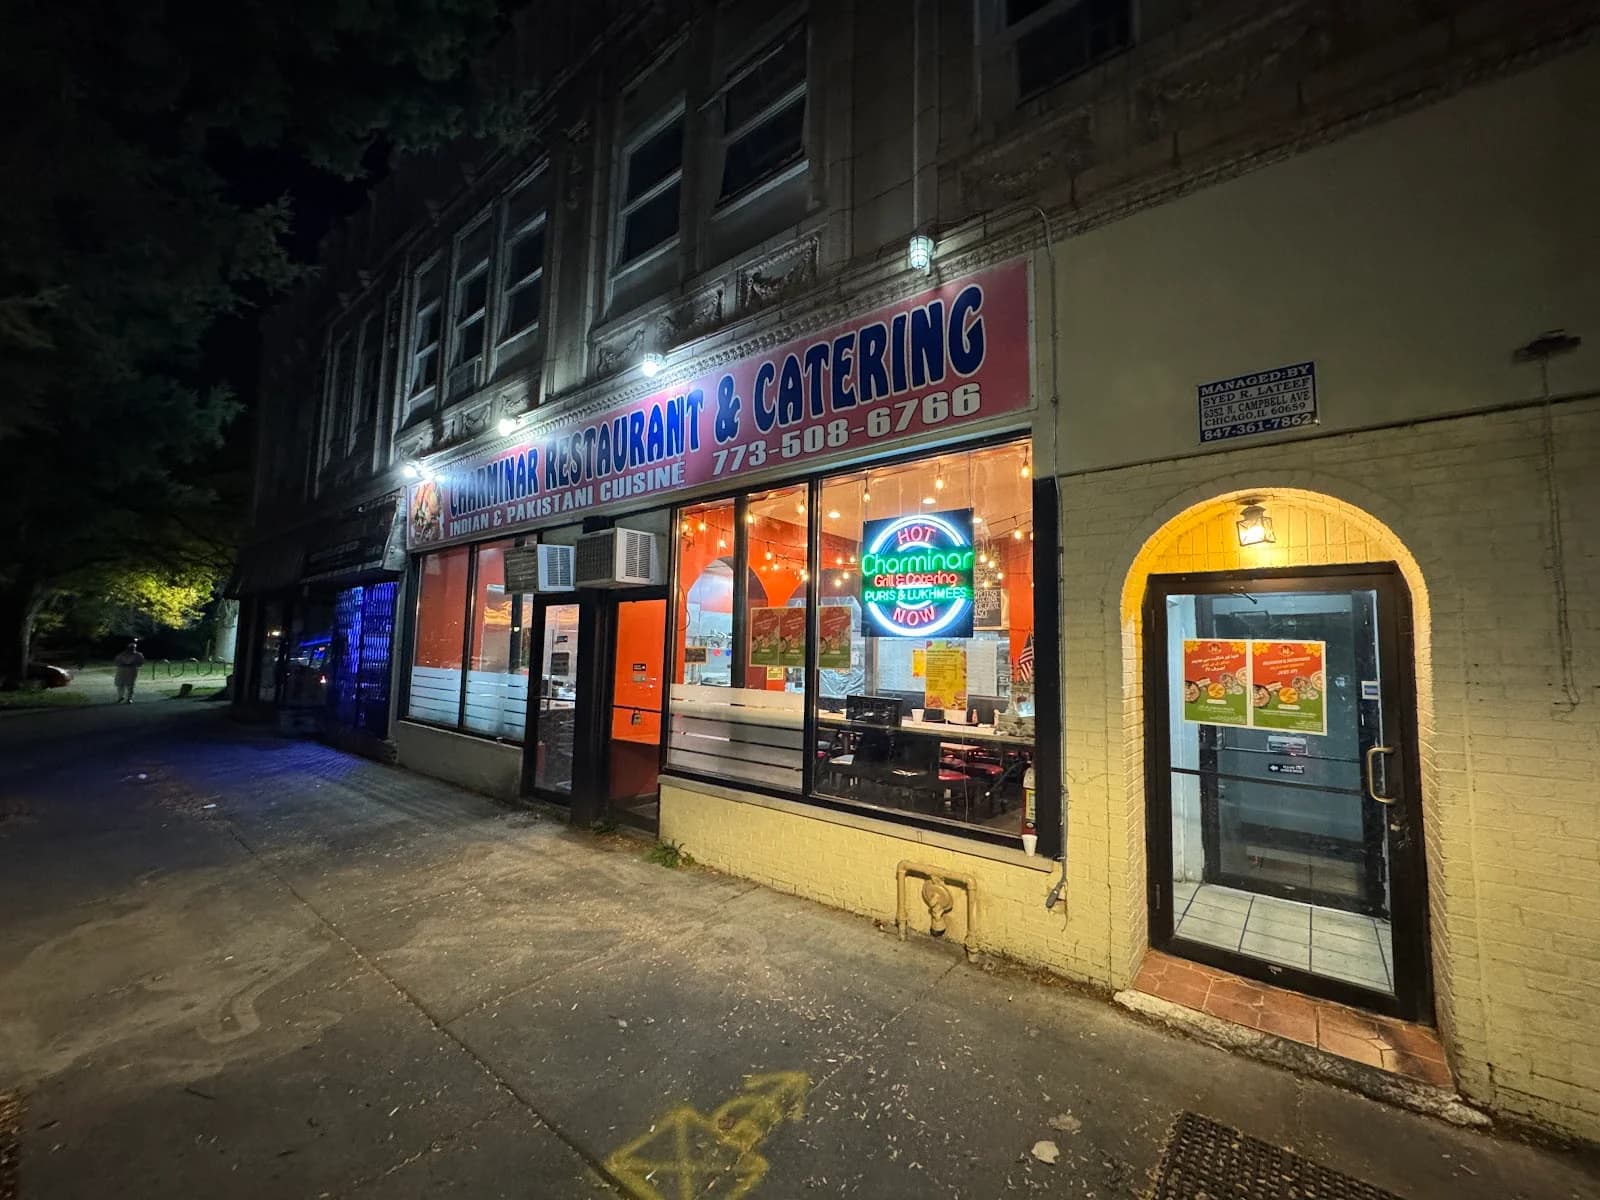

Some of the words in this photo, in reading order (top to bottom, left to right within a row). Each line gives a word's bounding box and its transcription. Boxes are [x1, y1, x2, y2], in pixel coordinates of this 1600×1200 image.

[449, 447, 540, 518] CHARMINAR
[545, 388, 704, 492] RESTAURANT
[714, 373, 742, 446] &
[753, 283, 986, 434] CATERING
[1203, 392, 1236, 407] SYED
[1240, 390, 1252, 399] R.
[1257, 378, 1310, 395] LATEEF
[1239, 395, 1287, 412] CAMPBELL
[1290, 390, 1311, 403] AVE
[1271, 402, 1306, 415] 60659
[712, 383, 981, 476] 773-508-6766
[1204, 413, 1312, 441] 847-361-7862
[450, 513, 489, 537] INDIAN
[493, 509, 503, 527] &
[506, 486, 593, 524] PAKISTANI
[600, 461, 685, 500] CUISINE
[897, 526, 936, 545] HOT
[861, 549, 974, 576] Charminar
[874, 574, 895, 587] Grill
[905, 570, 957, 587] Catering
[897, 588, 906, 601] &
[907, 586, 967, 600] LUKHMEES
[893, 604, 935, 626] NOW
